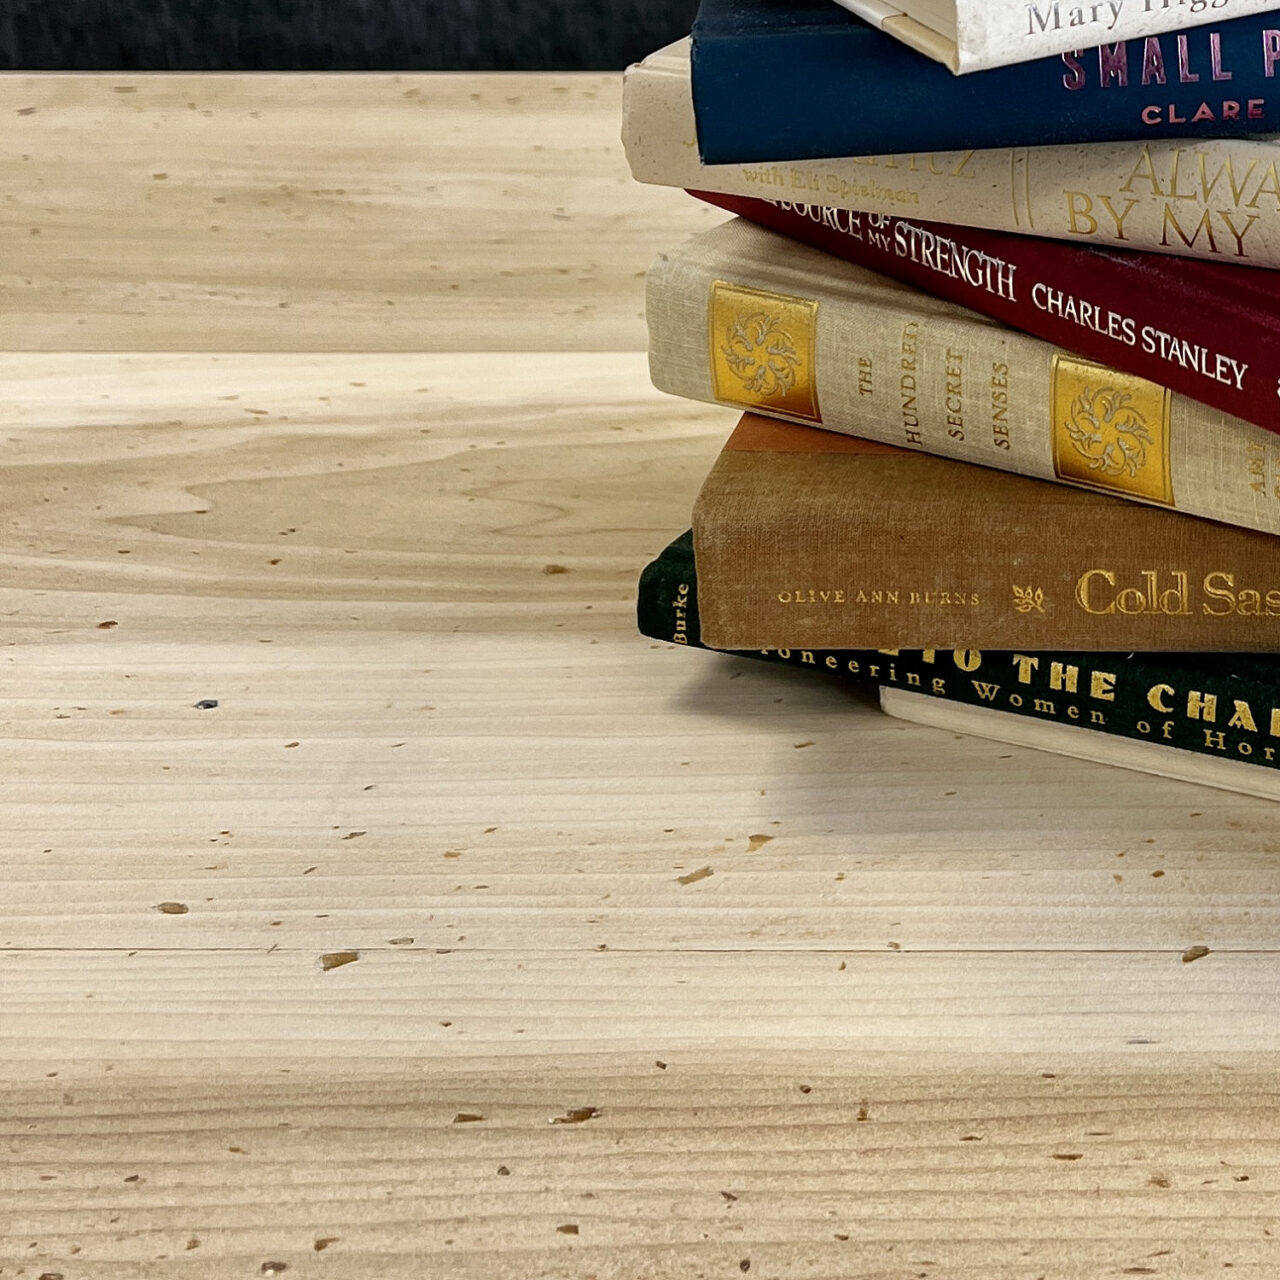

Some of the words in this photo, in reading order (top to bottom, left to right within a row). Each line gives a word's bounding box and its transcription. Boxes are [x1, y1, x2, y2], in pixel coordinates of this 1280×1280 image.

[1025, 0, 1126, 35] Mary
[1061, 33, 1233, 91] SMALL
[1141, 98, 1266, 125] CLARE
[742, 165, 785, 186] with
[790, 168, 820, 191] Eli
[1062, 190, 1140, 241] BY
[1158, 202, 1262, 258] MY
[868, 229, 891, 253] MY
[894, 220, 1018, 302] STRENGTH
[1031, 282, 1136, 346] CHARLES
[1141, 326, 1249, 390] STANLEY
[857, 357, 873, 396] THE
[901, 321, 923, 447] HUNDRED
[945, 347, 965, 442] SECRET
[991, 361, 1011, 451] SENSES
[673, 583, 690, 645] Burke
[778, 589, 846, 604] OLIVE
[855, 589, 899, 605] ANN
[909, 591, 981, 606] BURNS
[1074, 569, 1194, 616] Cold
[760, 649, 946, 695] oneering
[970, 679, 1107, 726] Women
[1136, 720, 1175, 740] of
[1012, 653, 1117, 702] THE
